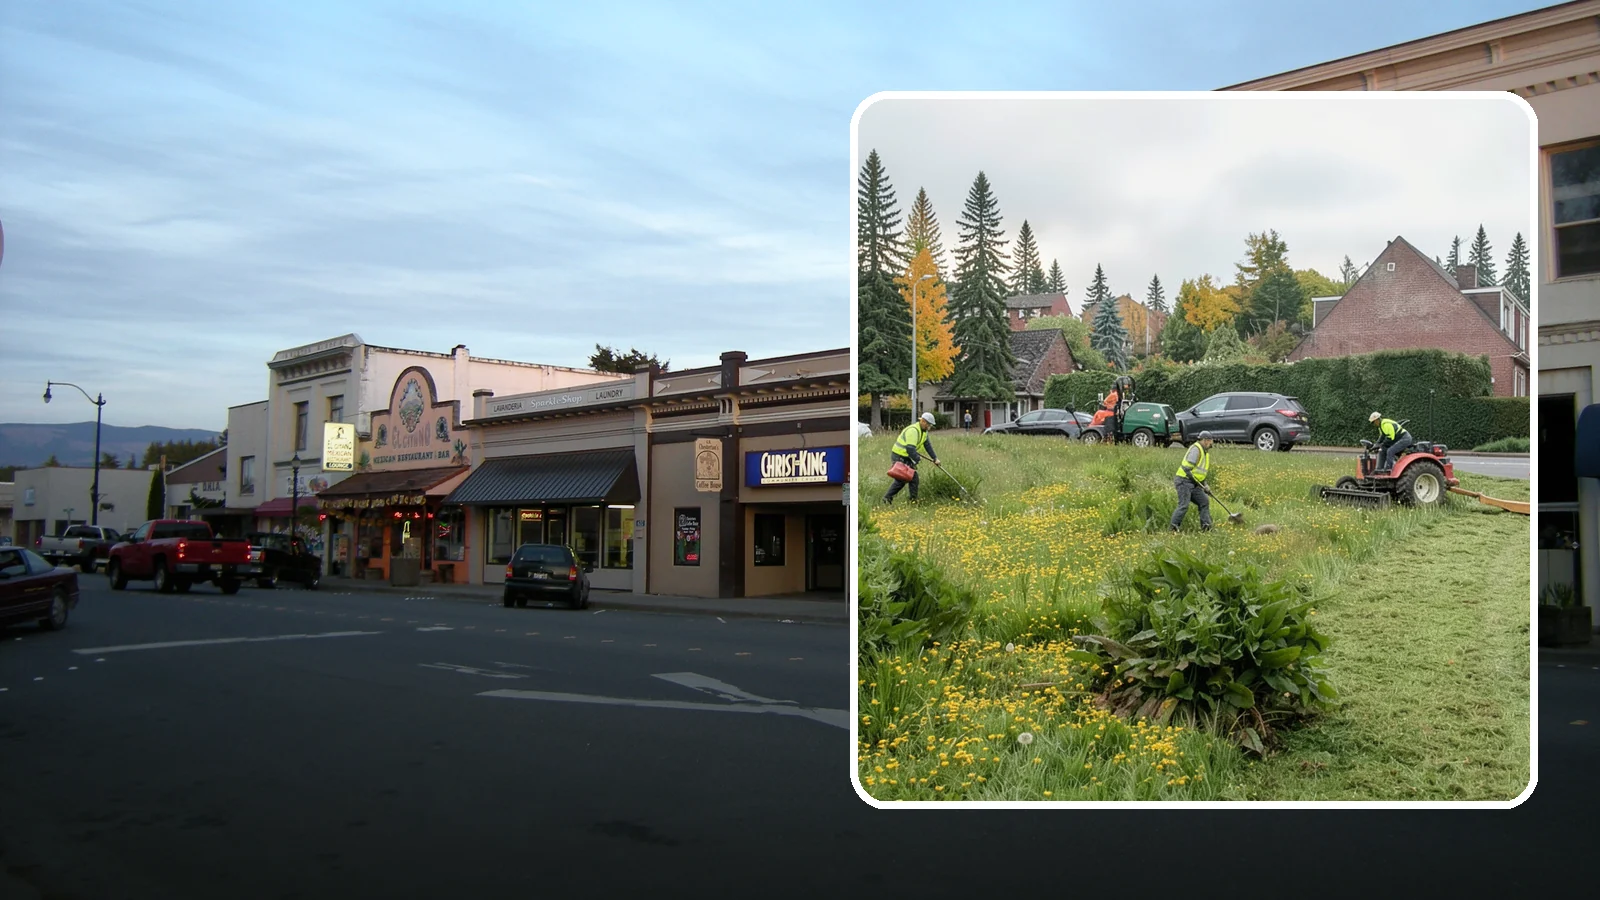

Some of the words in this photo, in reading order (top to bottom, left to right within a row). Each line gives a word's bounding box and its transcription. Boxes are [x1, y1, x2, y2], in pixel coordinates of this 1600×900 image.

[493, 402, 522, 412] LAVANDERIA
[595, 389, 623, 400] LAUNDRY
[373, 455, 396, 464] MEXICAN
[397, 451, 433, 462] RESTAURANT
[438, 450, 450, 459] BAR
[761, 452, 797, 478] CHRIST
[799, 450, 827, 476] KING
